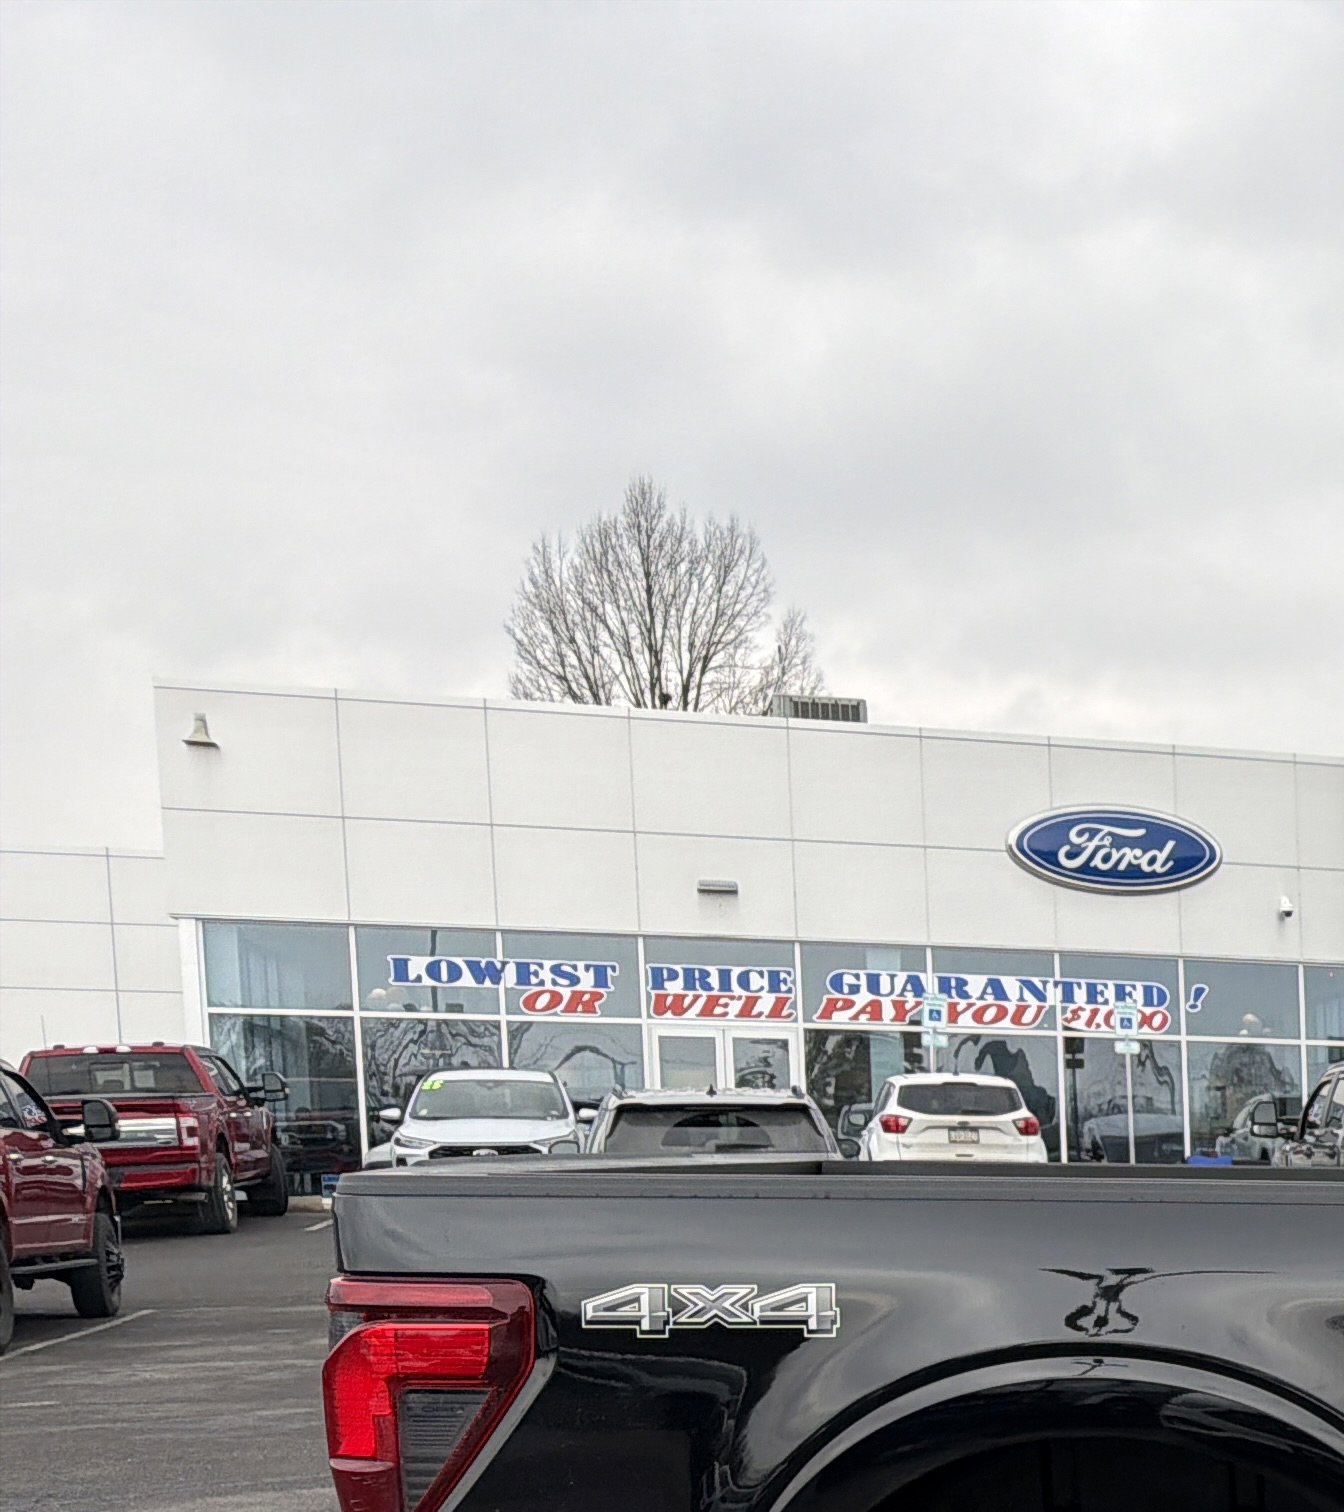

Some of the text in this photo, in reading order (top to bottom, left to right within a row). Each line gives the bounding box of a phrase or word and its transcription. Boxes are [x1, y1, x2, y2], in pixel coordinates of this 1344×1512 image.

[1057, 823, 1177, 873] Ford
[391, 957, 616, 990] LOWEST
[649, 965, 792, 994] PRICE
[828, 971, 1168, 1008] GUARANTEED
[522, 989, 605, 1015] OR
[651, 992, 793, 1020] WE'LL
[816, 997, 922, 1023] PAY
[945, 1002, 1046, 1027] YOU
